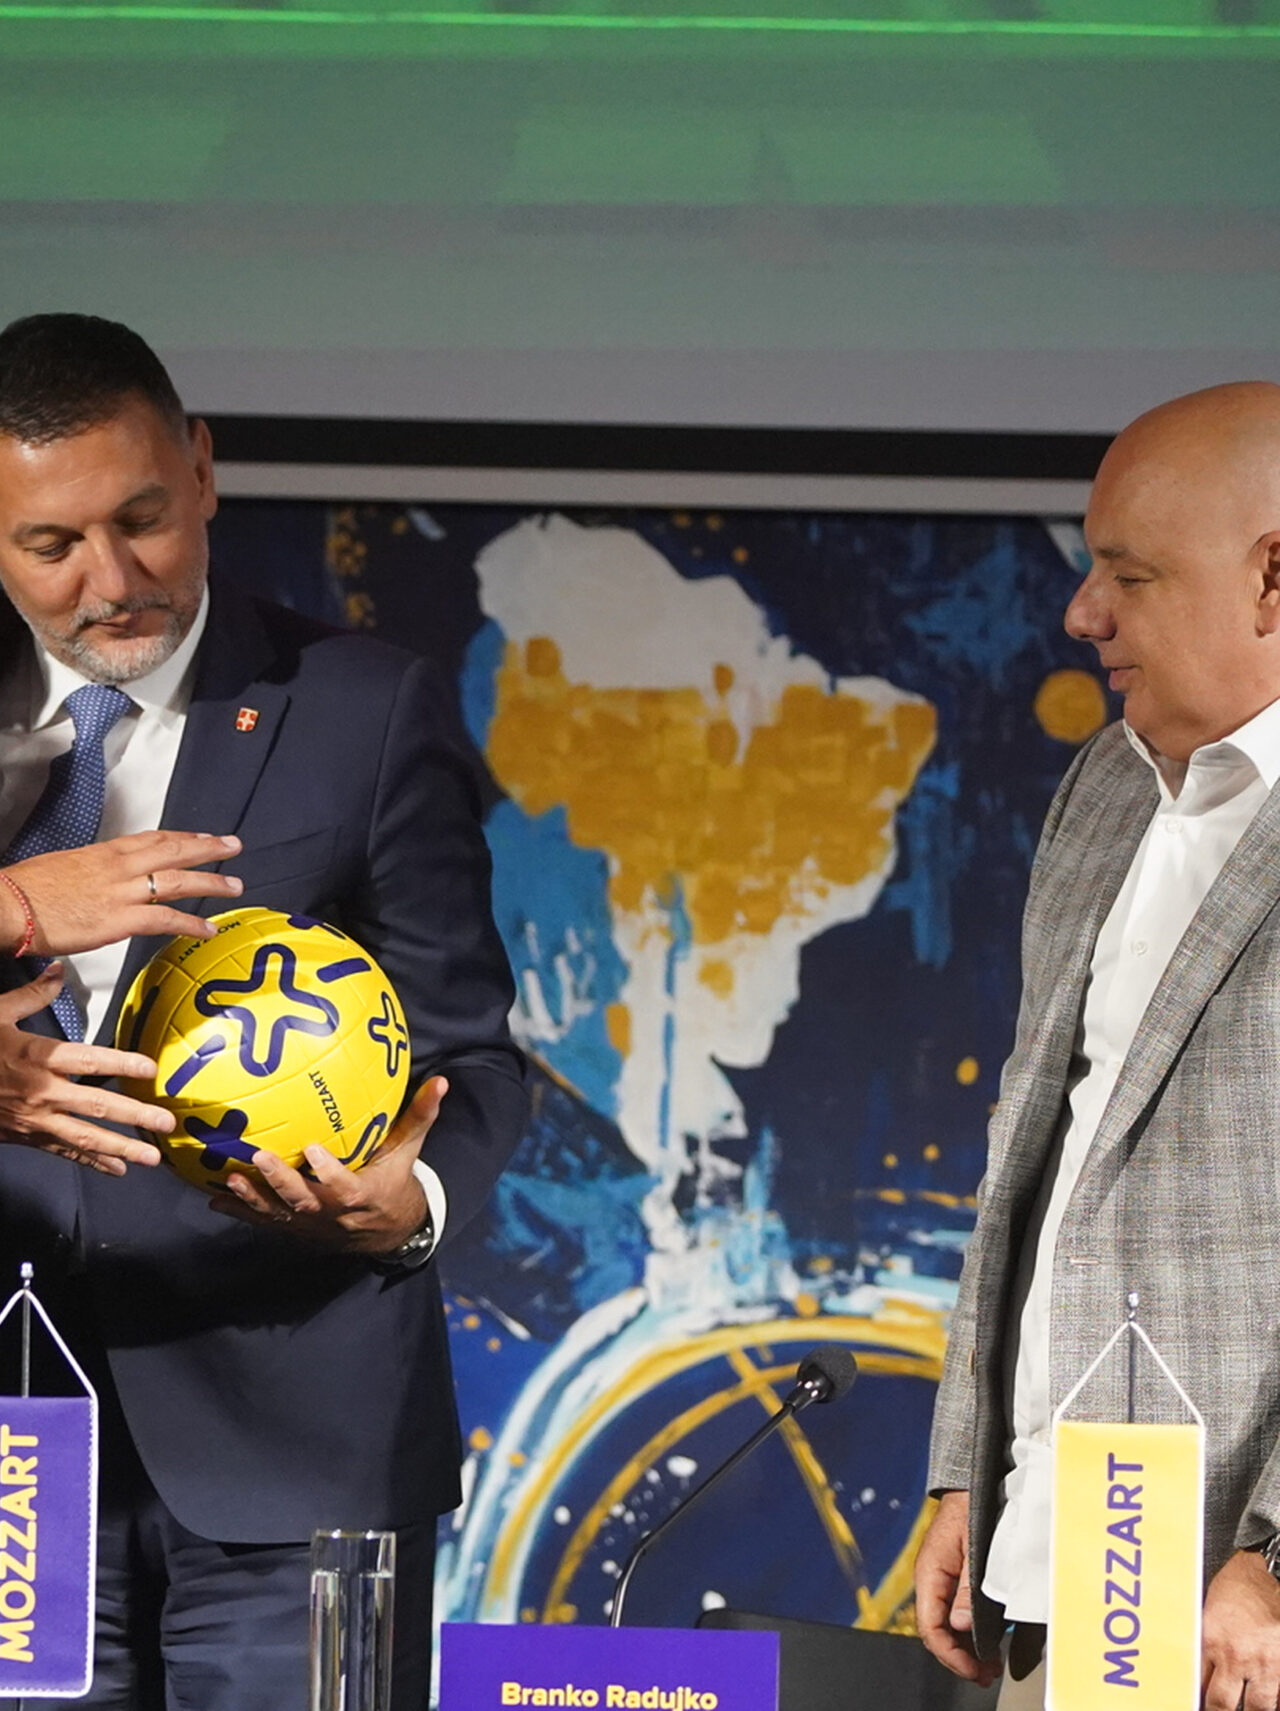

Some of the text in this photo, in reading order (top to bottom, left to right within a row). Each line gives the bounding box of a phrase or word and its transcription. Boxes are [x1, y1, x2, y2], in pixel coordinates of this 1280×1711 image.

[178, 920, 241, 963] MOART
[308, 1070, 345, 1133] MOZZART
[1103, 1452, 1144, 1688] MOZZART
[501, 1681, 719, 1711] Branko Radujko
